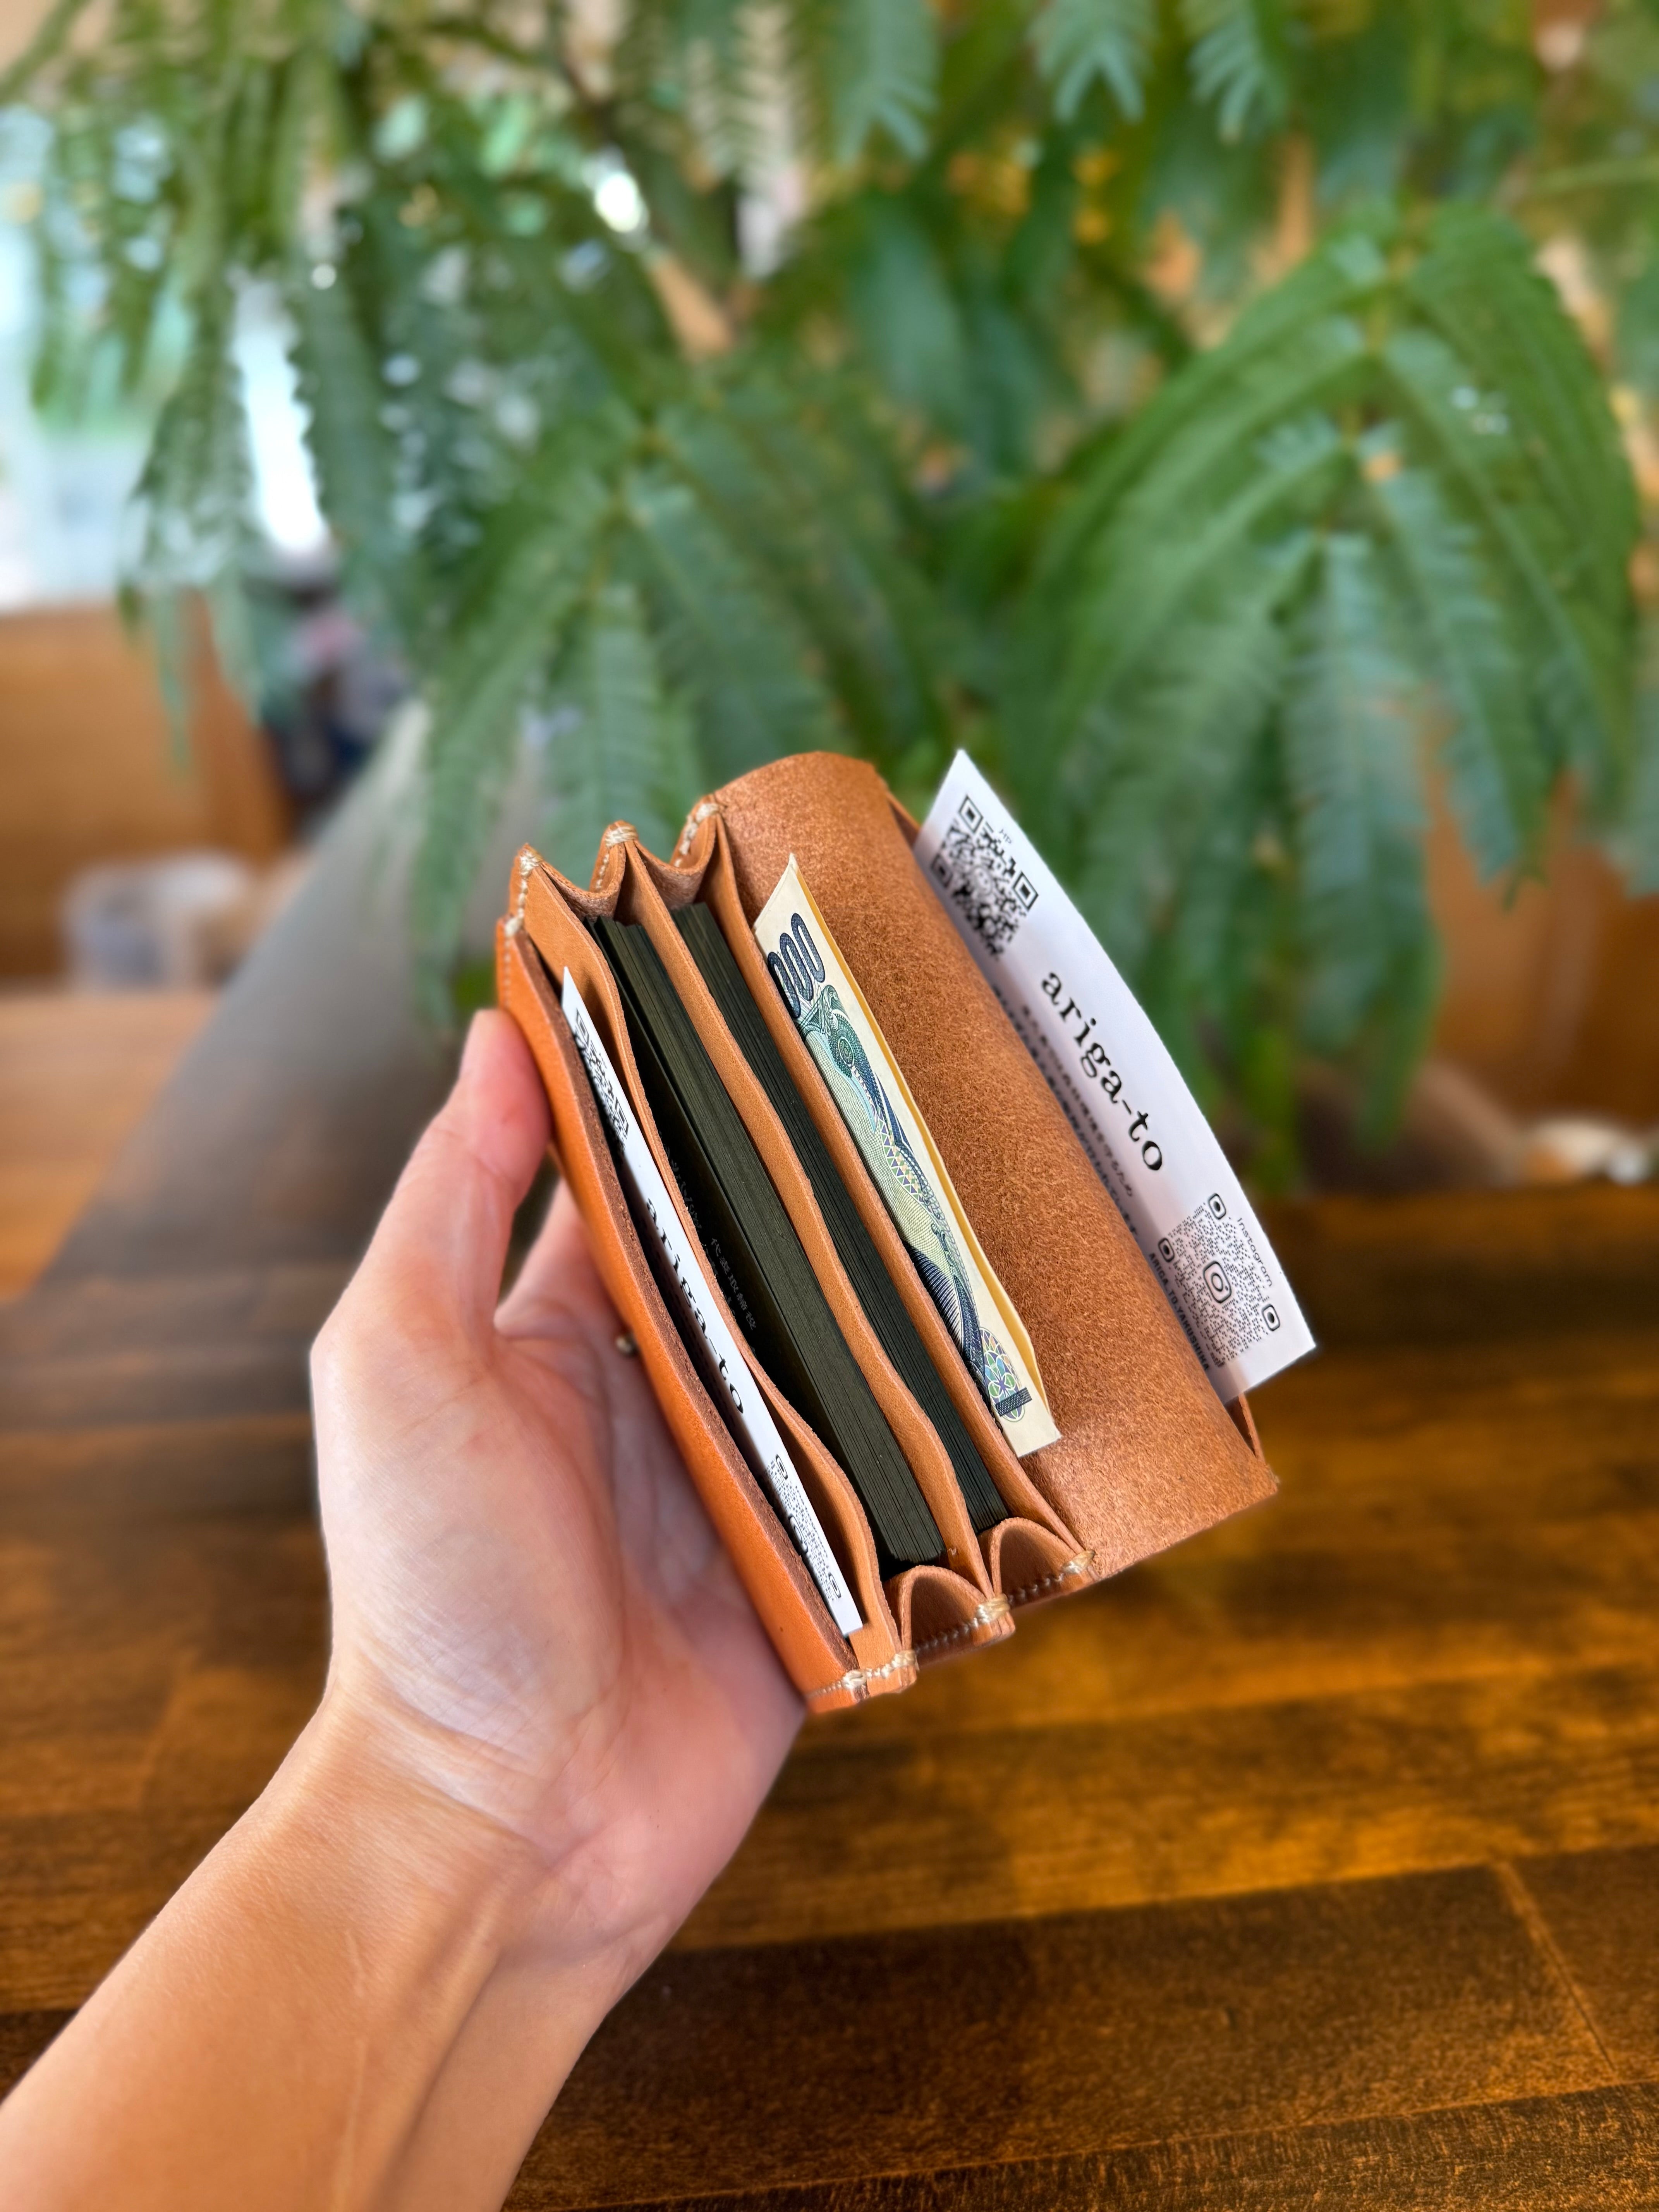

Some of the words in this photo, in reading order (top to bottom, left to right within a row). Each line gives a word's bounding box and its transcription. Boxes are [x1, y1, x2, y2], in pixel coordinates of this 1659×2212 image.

[1042, 972, 1162, 1171] ariga-to
[647, 1198, 743, 1413] ariga-to
[1236, 1217, 1273, 1287] Instagram
